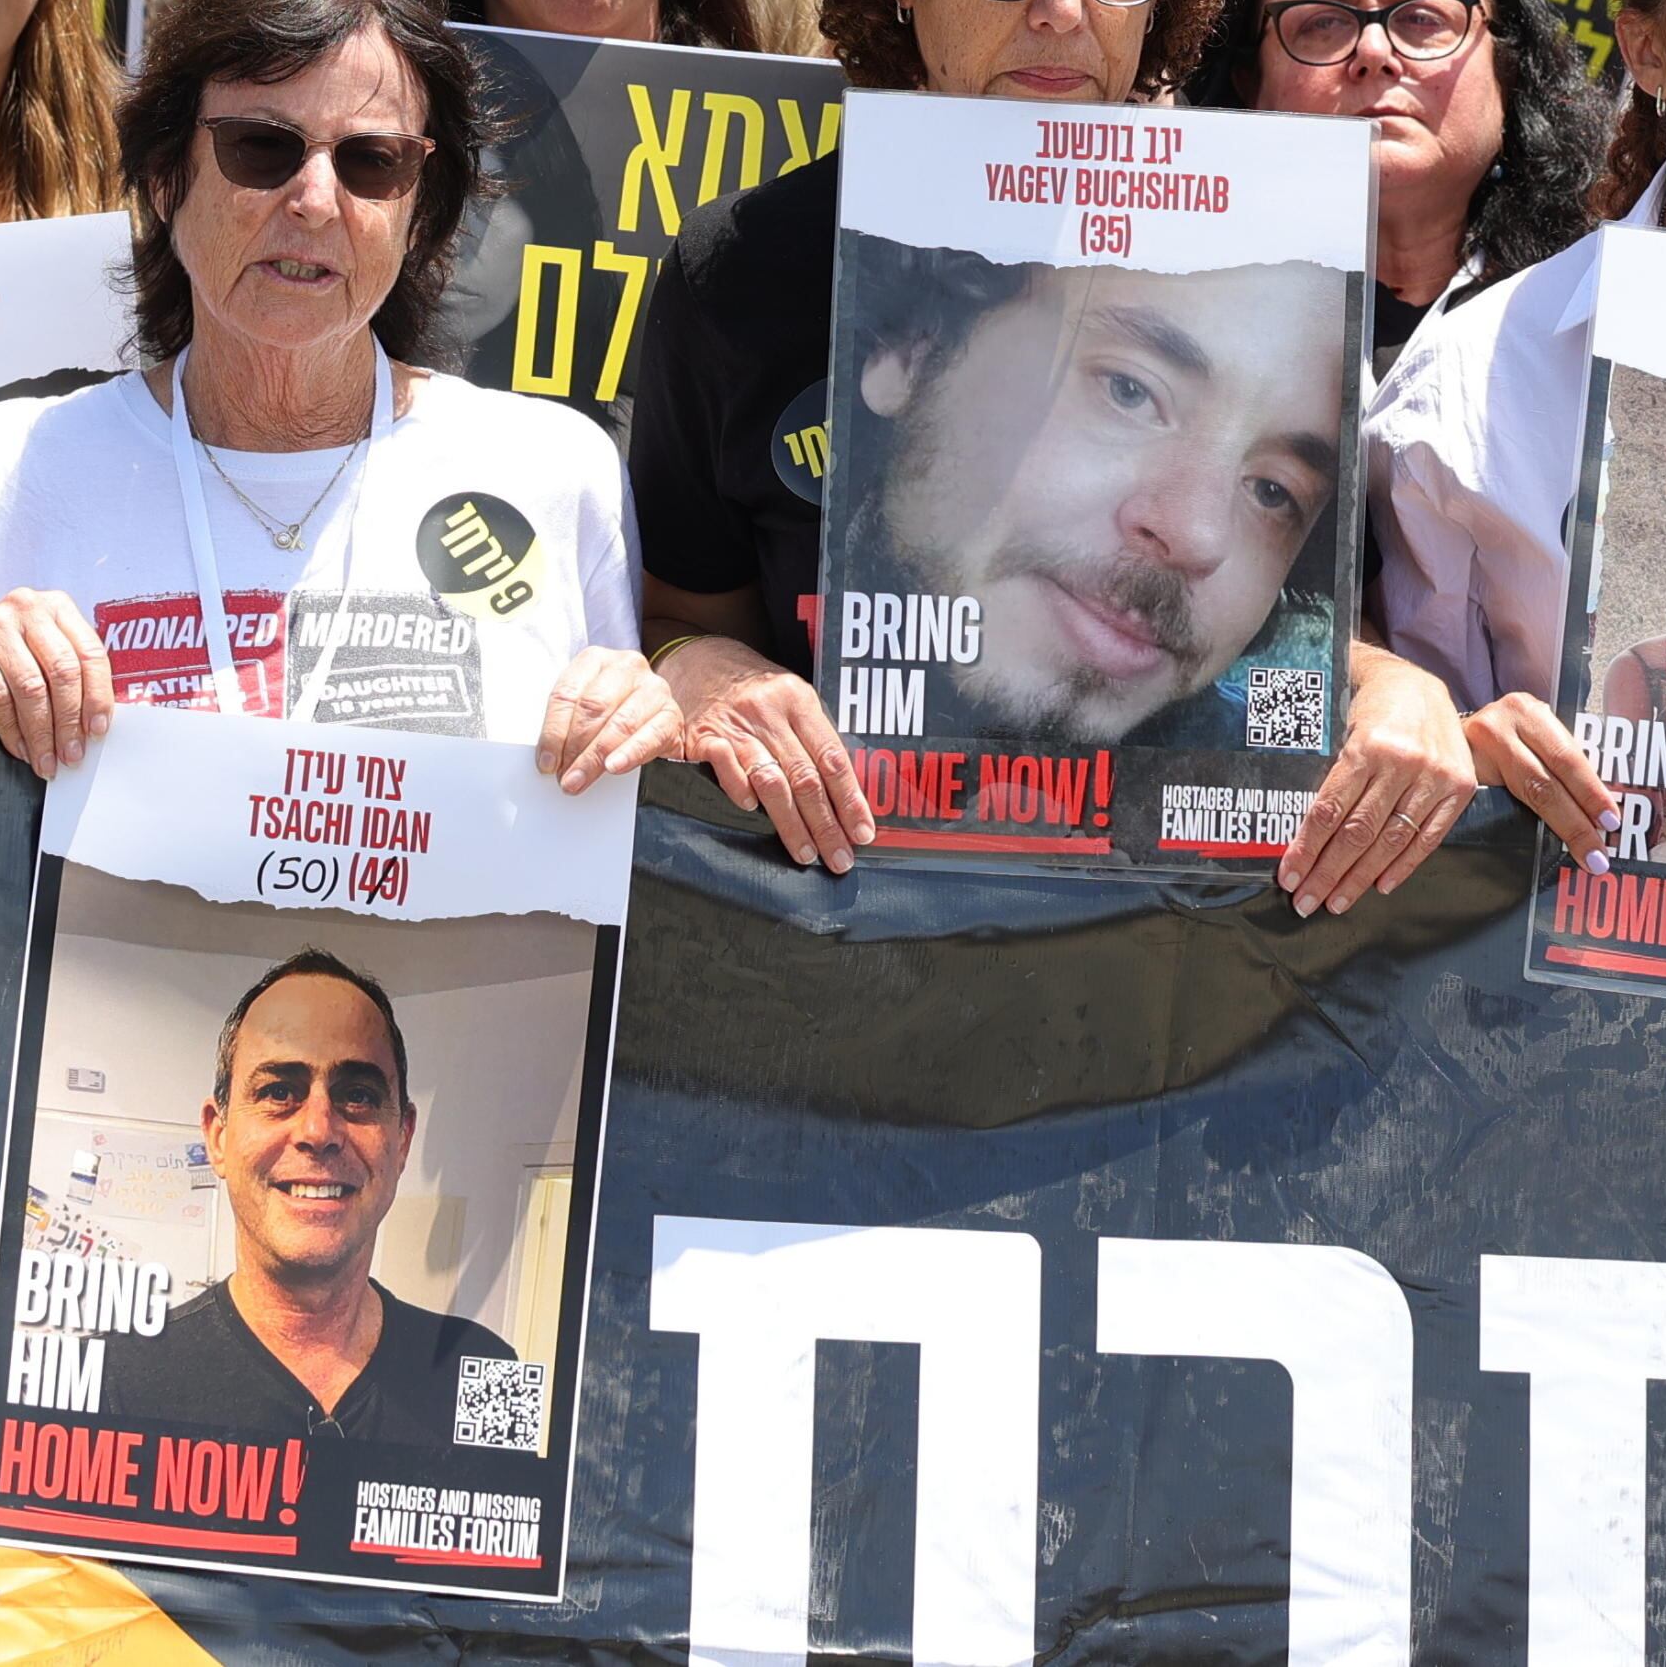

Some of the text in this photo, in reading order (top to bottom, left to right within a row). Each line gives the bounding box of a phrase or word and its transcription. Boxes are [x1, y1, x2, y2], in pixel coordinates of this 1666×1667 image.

[1035, 121, 1182, 167] יגב בוכשטב
[985, 163, 1230, 213] YAGEV BUCHSHTAB
[1080, 212, 1133, 259] (35)
[490, 580, 534, 615] 9
[104, 613, 277, 652] KIDNAPED
[842, 592, 982, 664] BRING
[321, 676, 456, 702] DAUGHTER
[332, 700, 355, 714] 18
[361, 697, 418, 715] years
[837, 666, 925, 736] HIM
[285, 749, 407, 802] צחי עידן
[978, 750, 1114, 828] NOW!
[1162, 785, 1264, 814] HOSTAGES AND
[249, 794, 432, 855] TSACHI IDAN
[1161, 809, 1252, 843] FAMILIES
[256, 852, 339, 900] (50)
[17, 1257, 171, 1337] BRING
[6, 1337, 107, 1415] HIM
[153, 1437, 306, 1525] NOW!
[357, 1480, 541, 1523] HOSTAGES AND MISSING
[353, 1504, 539, 1561] FAMILIES FORUM
